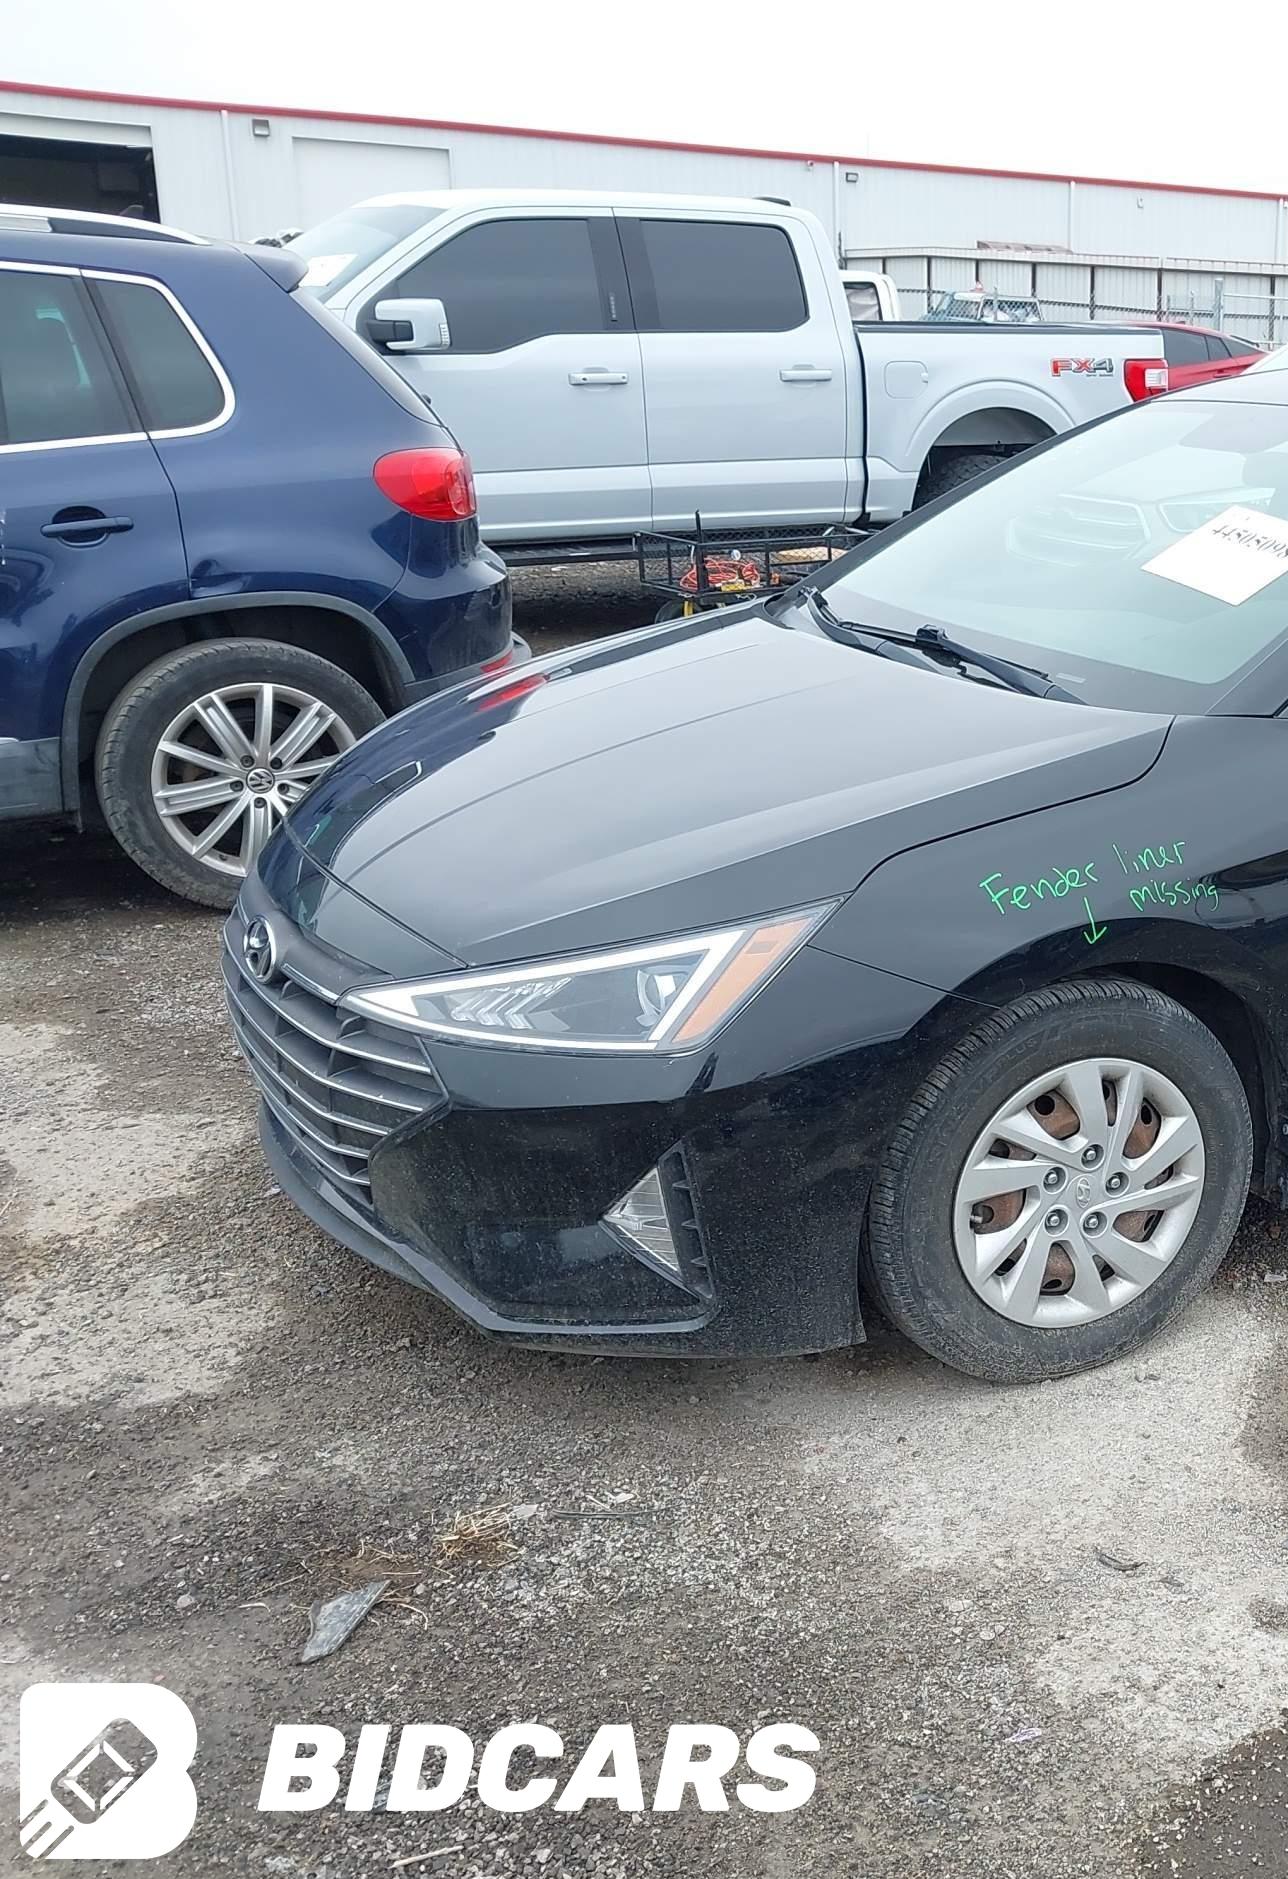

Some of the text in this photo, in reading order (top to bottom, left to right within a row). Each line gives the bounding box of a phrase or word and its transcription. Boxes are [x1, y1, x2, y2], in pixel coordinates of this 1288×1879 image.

[1050, 358, 1114, 377] FX4
[978, 861, 1099, 915] Fender
[1129, 876, 1220, 912] missing
